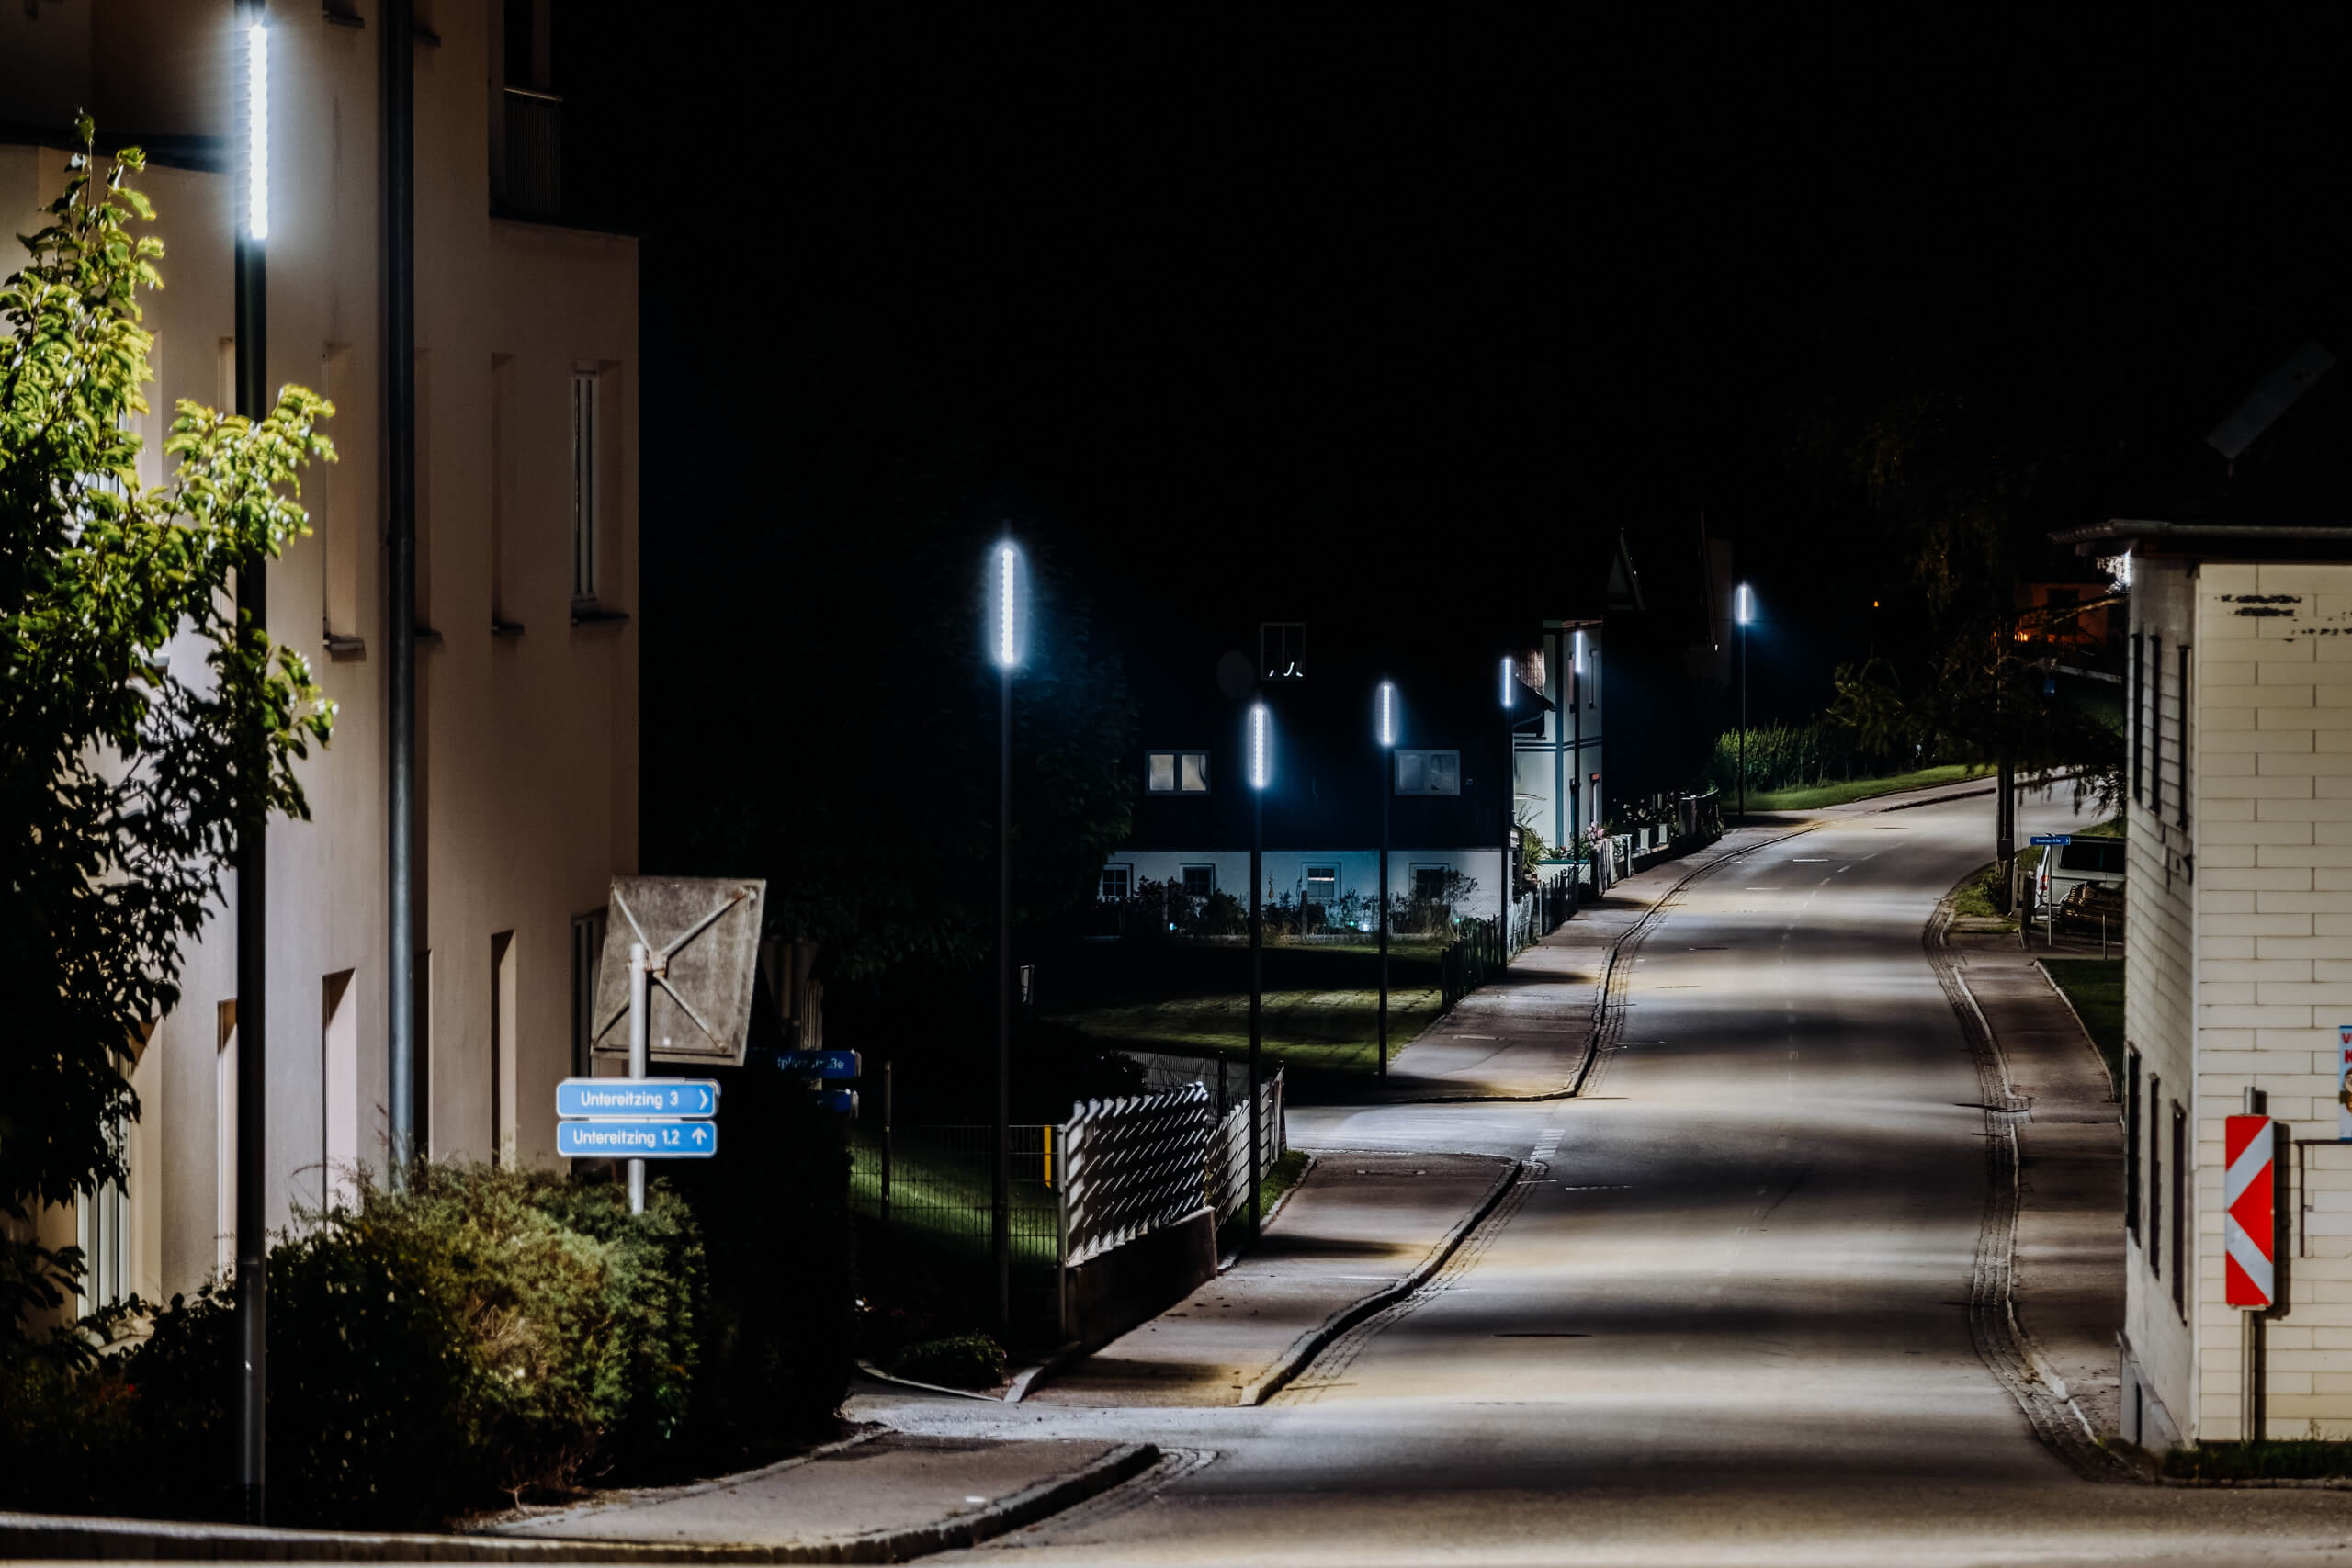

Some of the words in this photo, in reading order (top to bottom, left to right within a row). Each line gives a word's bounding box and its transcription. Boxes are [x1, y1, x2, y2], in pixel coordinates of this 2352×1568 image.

[581, 1090, 663, 1110] Untereitzing
[670, 1090, 679, 1106] 3
[573, 1129, 656, 1148] Untereitzing
